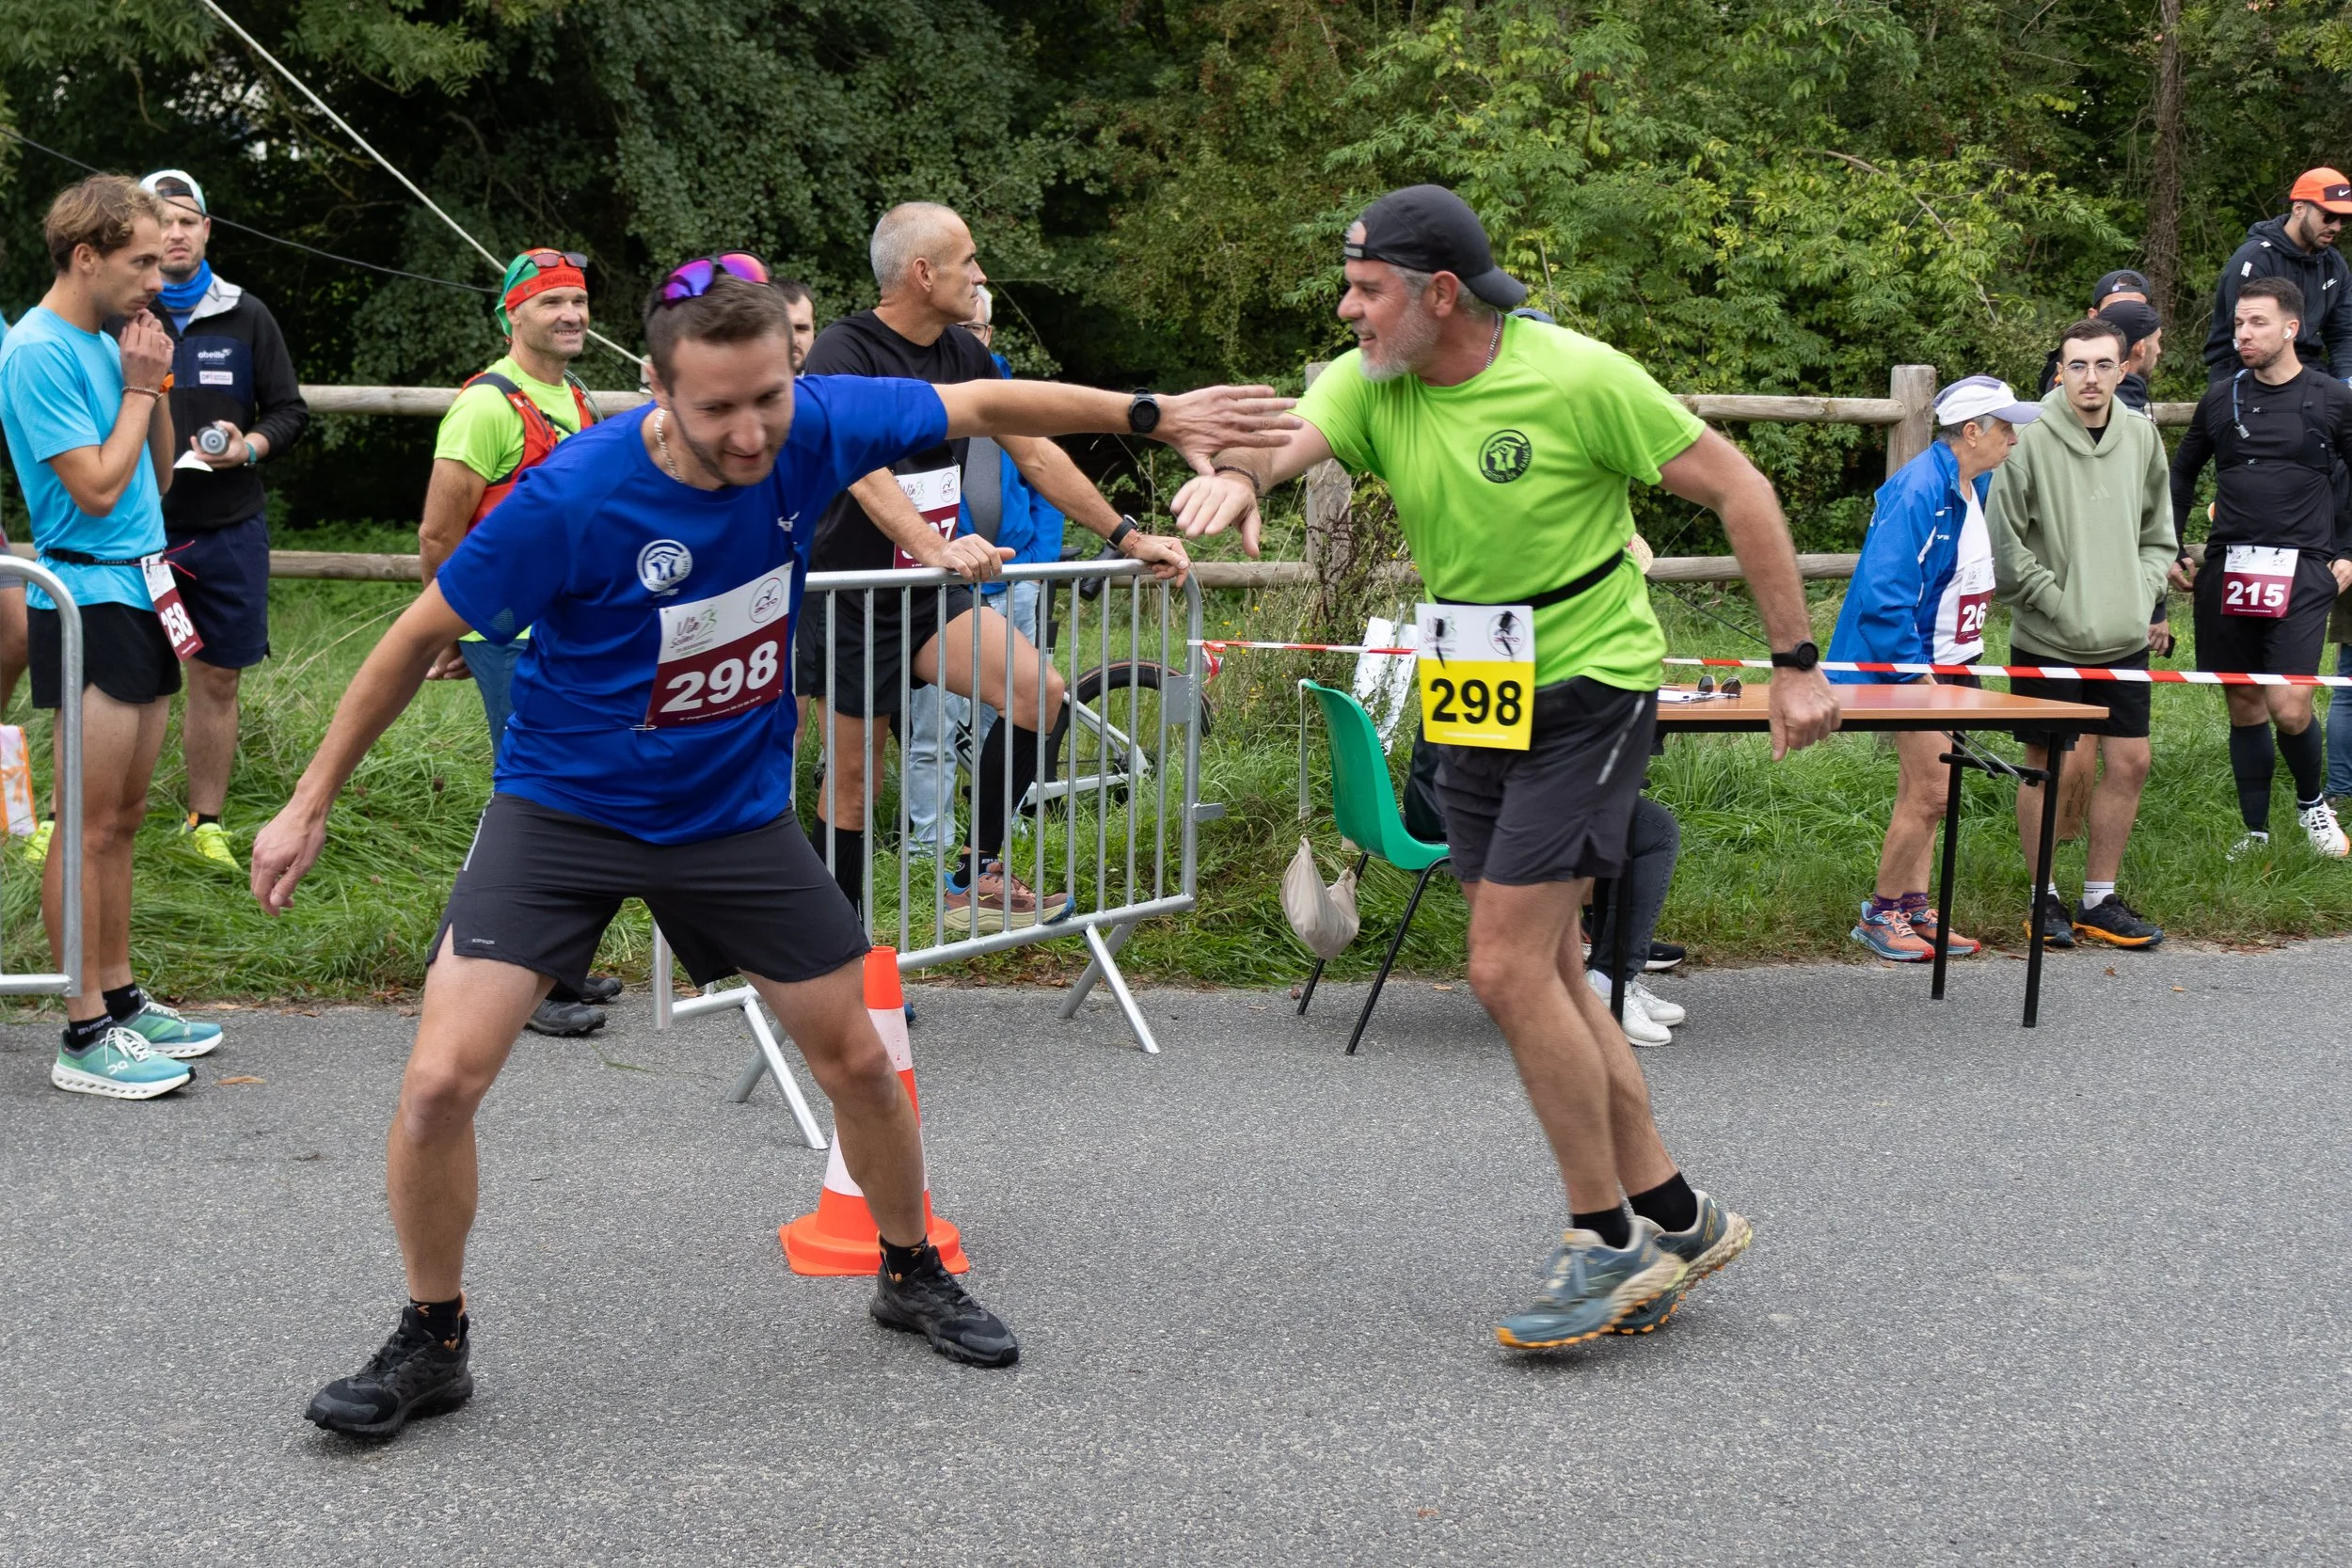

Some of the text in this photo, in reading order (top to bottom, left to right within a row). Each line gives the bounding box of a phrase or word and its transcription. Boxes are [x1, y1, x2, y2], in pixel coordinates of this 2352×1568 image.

[2226, 580, 2286, 608] 215
[160, 602, 194, 647] 258
[660, 641, 778, 713] 298
[1429, 677, 1522, 727] 298
